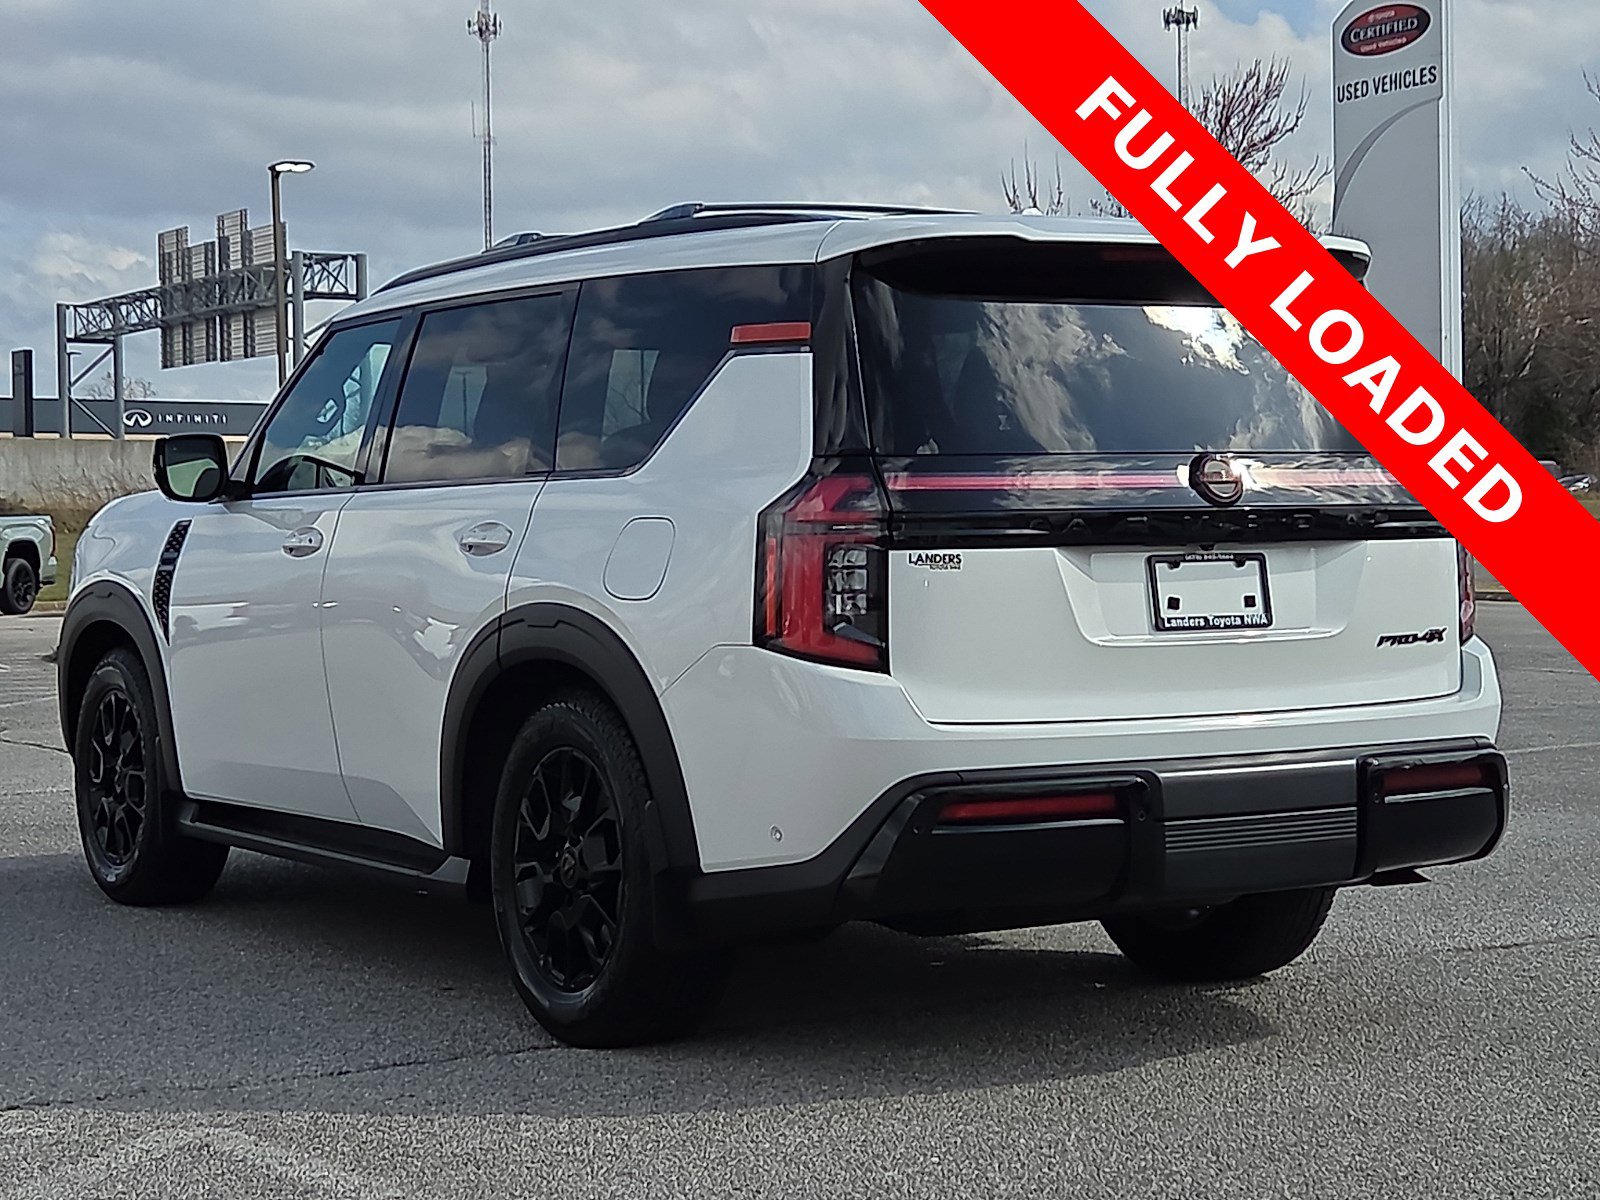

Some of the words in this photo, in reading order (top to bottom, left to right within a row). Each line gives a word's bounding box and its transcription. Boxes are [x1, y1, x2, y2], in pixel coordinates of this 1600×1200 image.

[1350, 17, 1418, 43] CERTIFIED
[1337, 80, 1369, 103] USED
[1373, 65, 1437, 95] VEHICLES
[158, 413, 227, 424] INFINITI
[909, 553, 962, 565] LANDERS
[1165, 616, 1205, 628] Landers
[1207, 615, 1241, 628] Toyota
[1244, 613, 1268, 625] NWA
